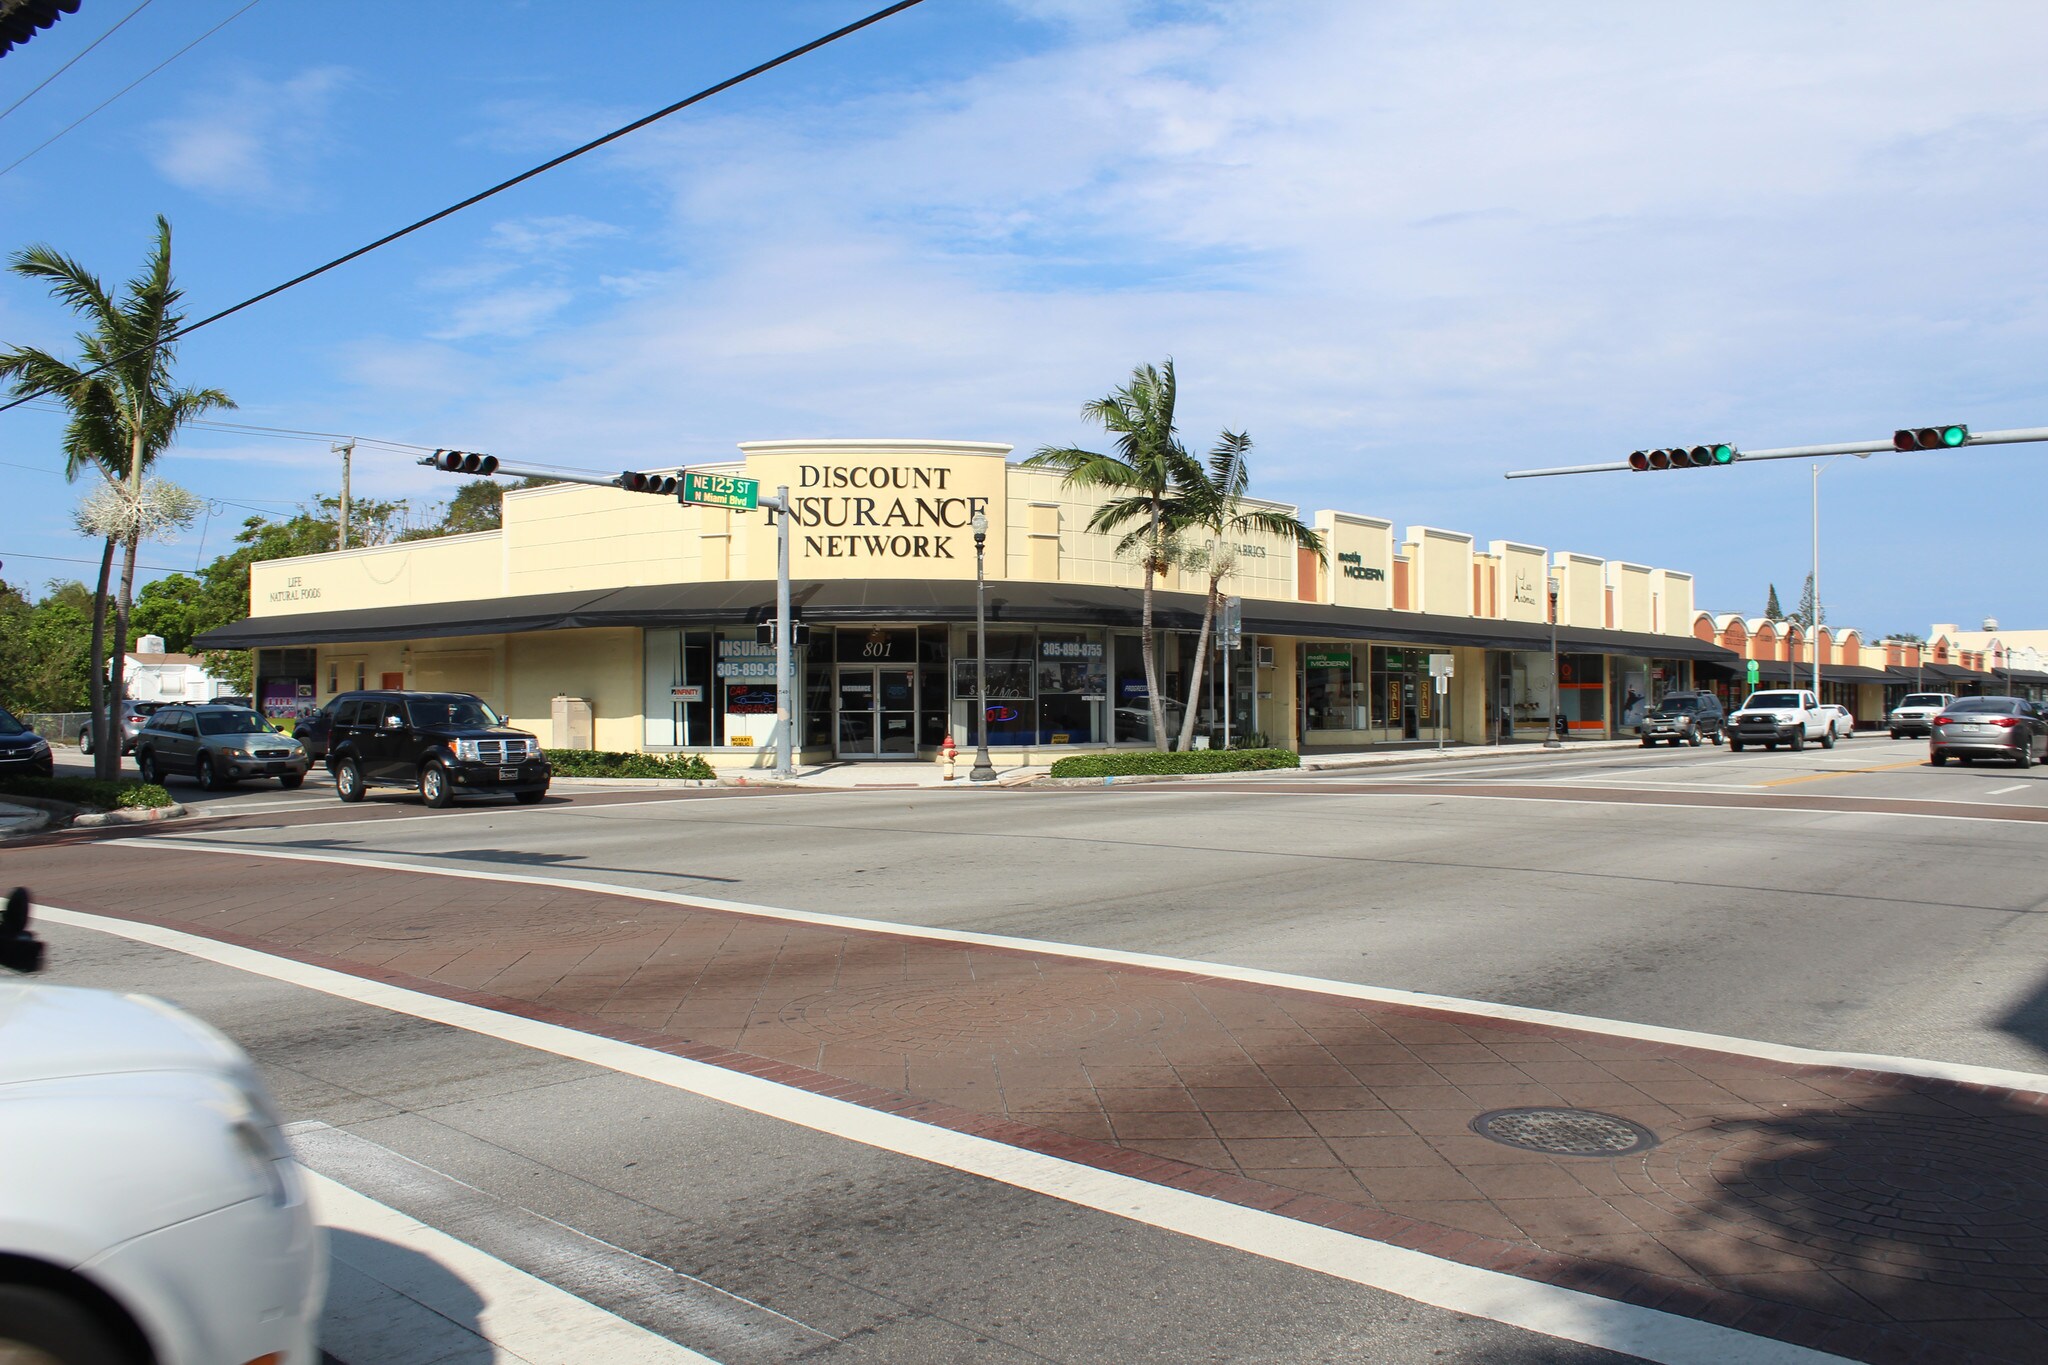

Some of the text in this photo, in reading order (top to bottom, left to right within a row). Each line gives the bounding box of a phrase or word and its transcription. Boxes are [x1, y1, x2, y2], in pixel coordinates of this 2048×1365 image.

[799, 465, 951, 489] DISCOUNT
[693, 475, 750, 494] NE 125 ST
[694, 491, 747, 506] N Miami Blvd
[804, 535, 954, 559] NETWORK
[1343, 565, 1384, 582] MODERN
[288, 576, 302, 588] LIFE
[270, 588, 321, 602] NATURAL FOODS
[862, 642, 892, 656] 801
[1043, 642, 1102, 656] 305-899-8755
[717, 662, 795, 676] 305-899-85
[729, 686, 748, 695] CAR
[268, 697, 292, 706] LIFE
[728, 704, 773, 713] INSURANCE
